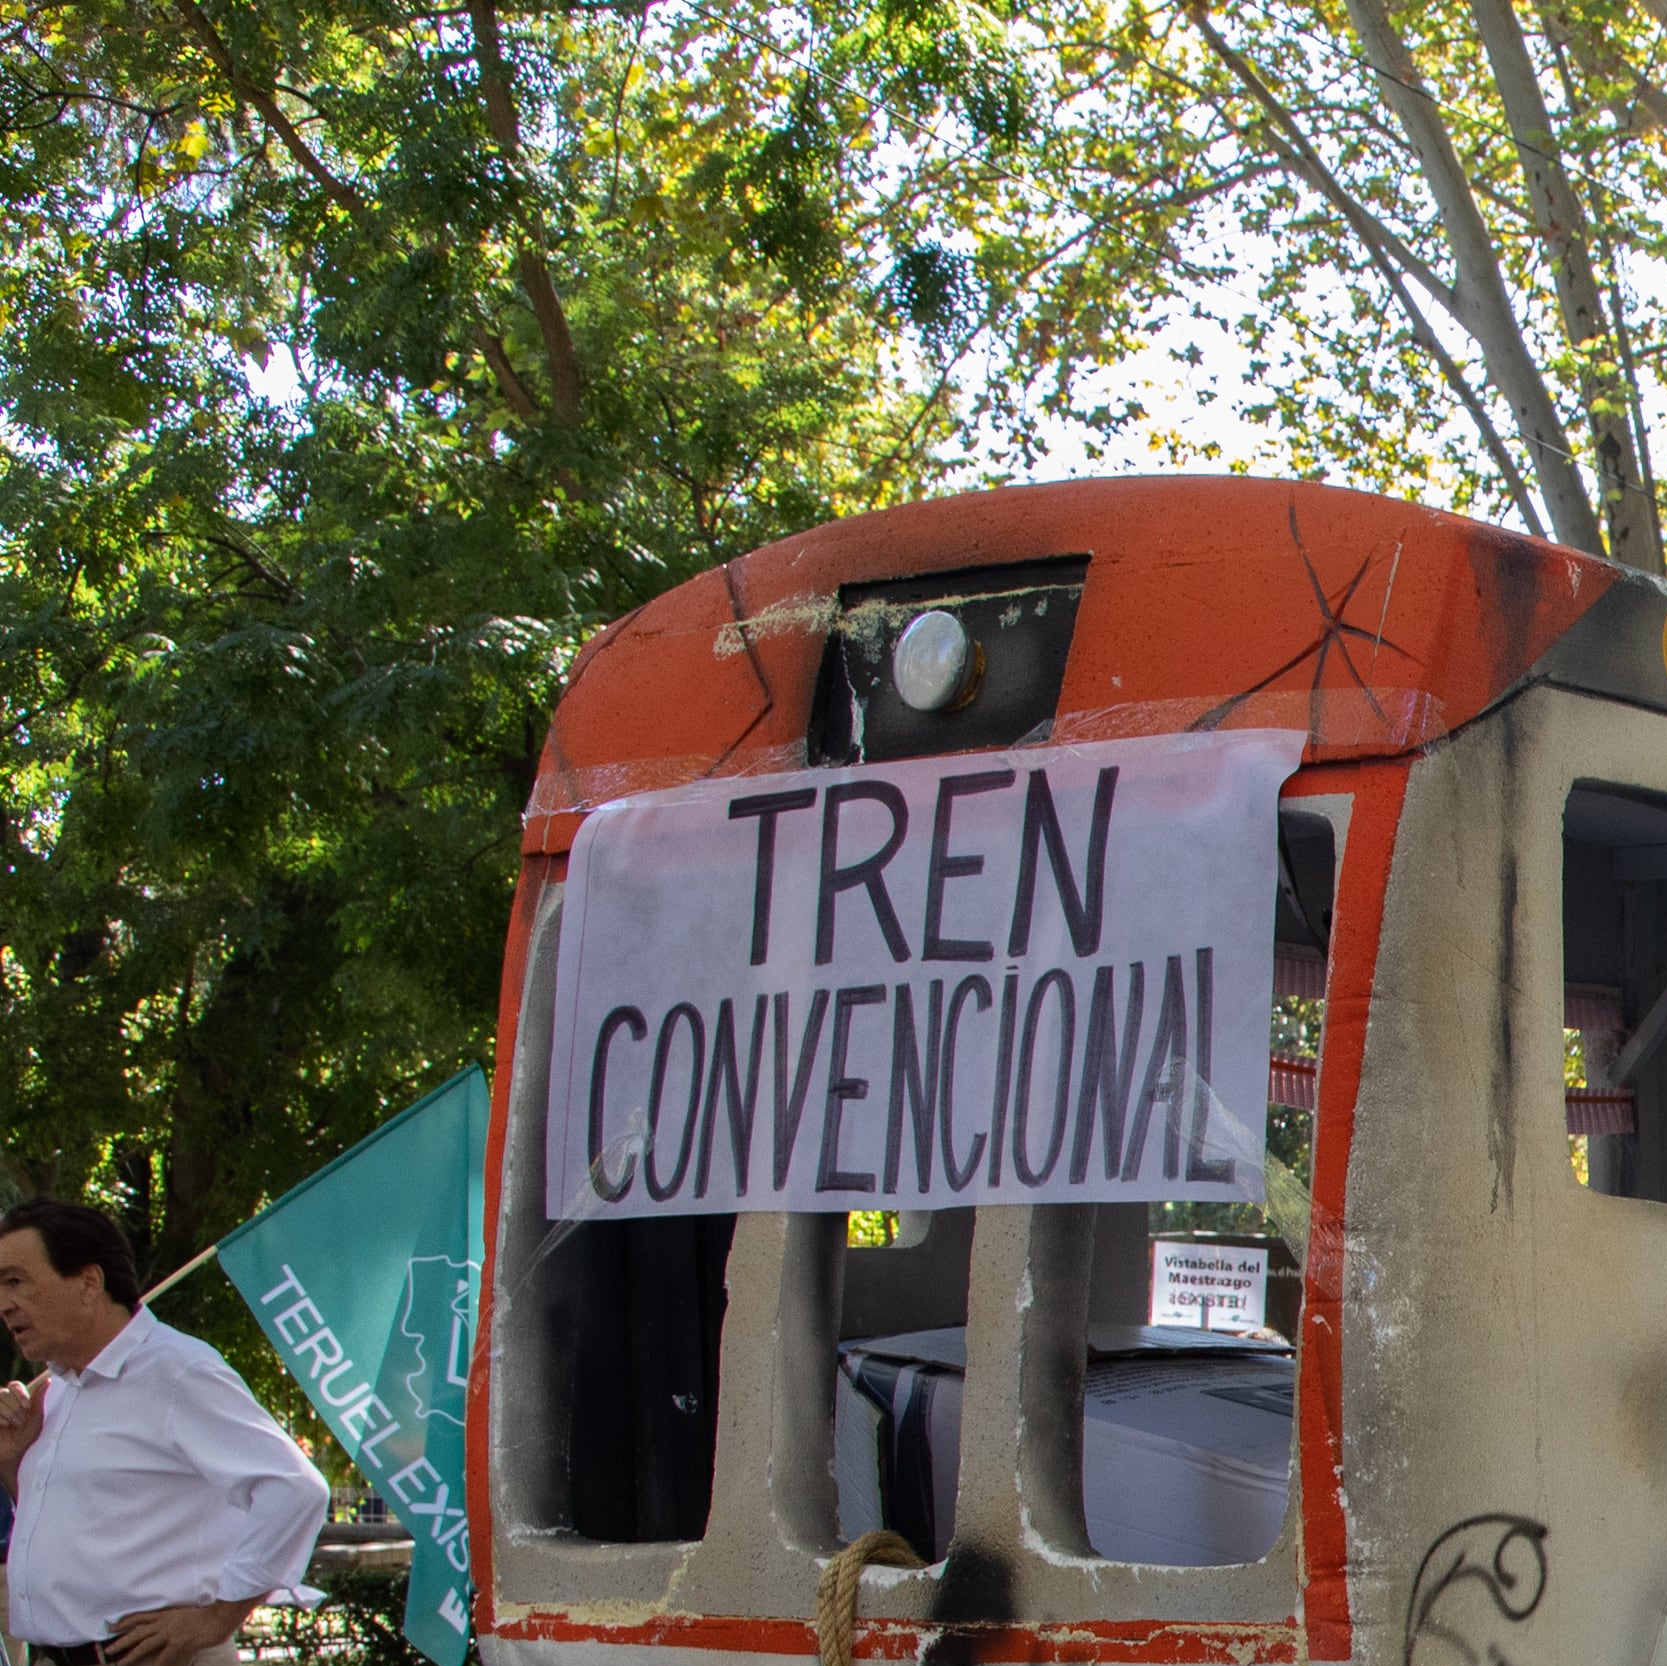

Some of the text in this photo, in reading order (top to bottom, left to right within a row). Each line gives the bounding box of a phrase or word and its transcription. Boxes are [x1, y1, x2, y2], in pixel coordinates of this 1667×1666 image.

[728, 766, 1119, 966] TREN
[588, 948, 1235, 1203] CONVENCIONAL
[1164, 1256, 1233, 1272] Vistabella
[1237, 1260, 1261, 1273] del
[1168, 1271, 1252, 1290] Maestrazgo
[260, 1264, 401, 1470] TERUEL
